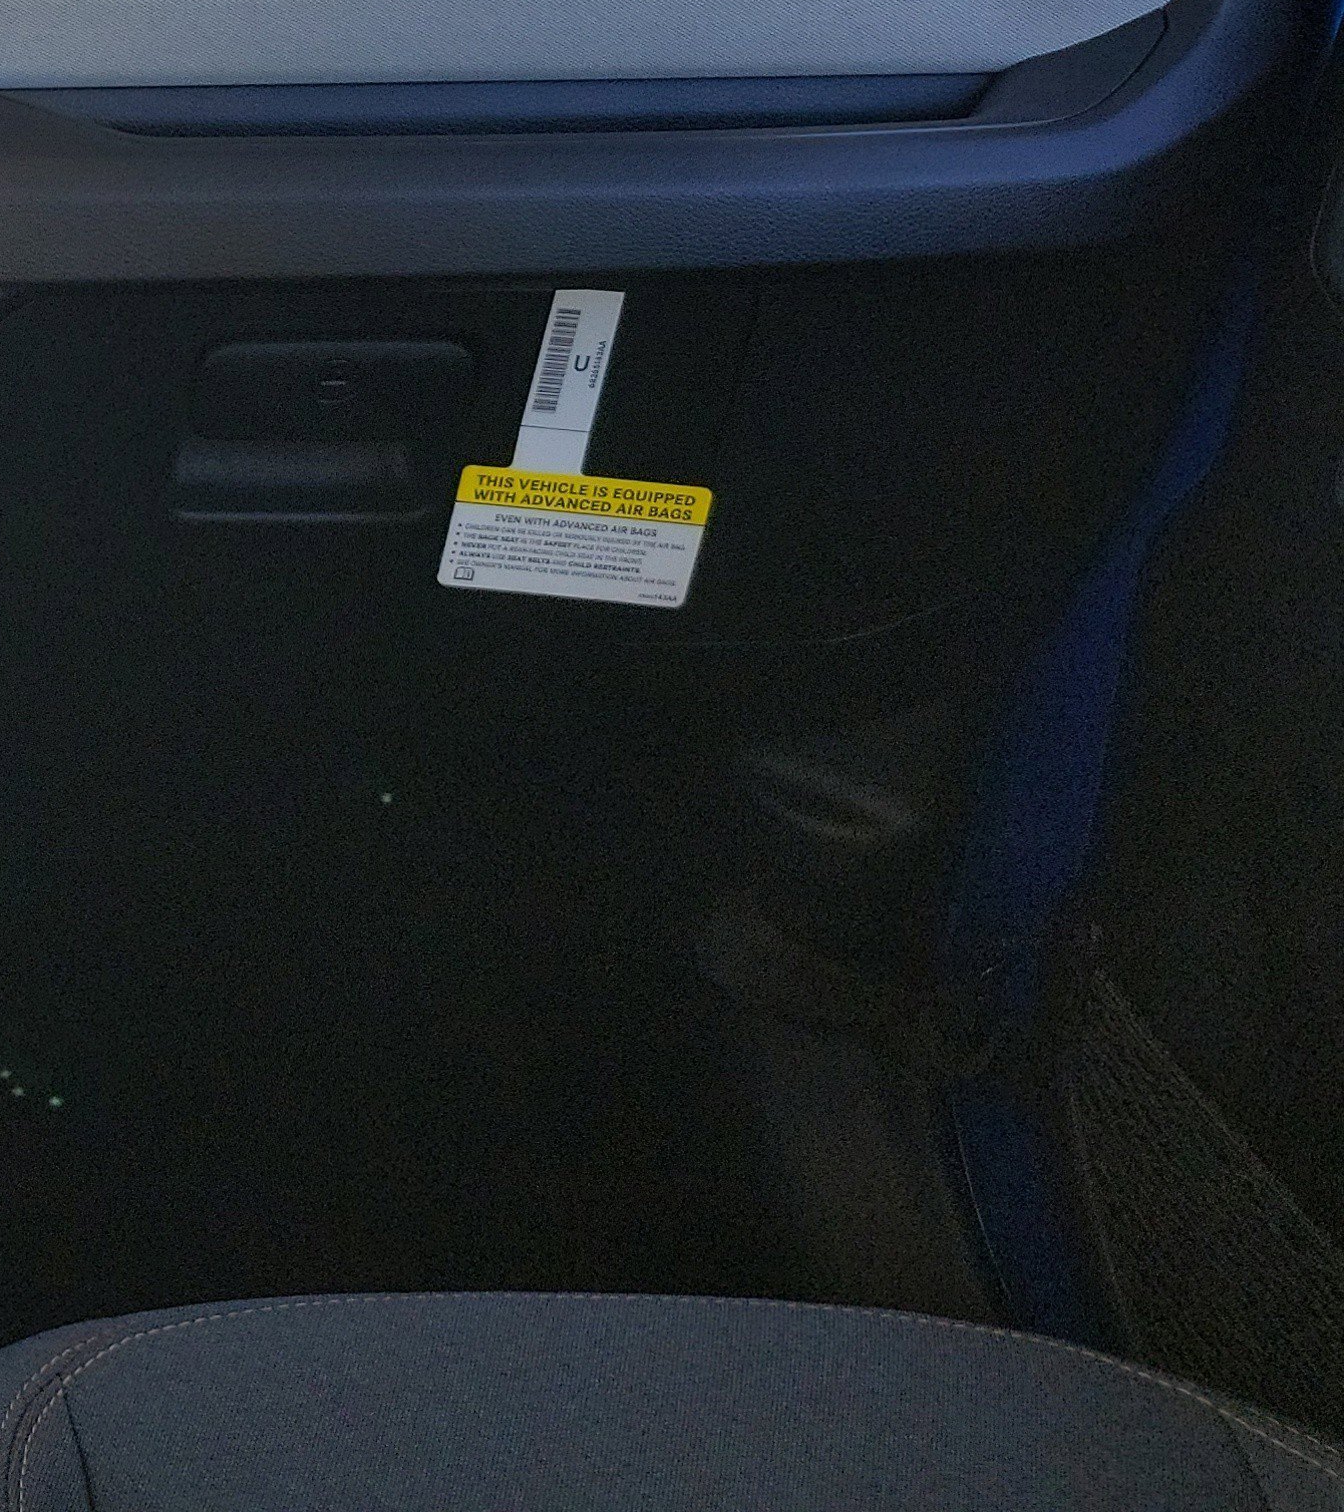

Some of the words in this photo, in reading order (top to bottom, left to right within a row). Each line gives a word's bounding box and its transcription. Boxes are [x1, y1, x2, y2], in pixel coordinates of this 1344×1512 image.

[574, 354, 590, 372] U
[477, 474, 514, 489] THIS
[519, 478, 587, 497] VEHICLE
[592, 485, 608, 498] IS
[613, 486, 696, 507] EQUIPPED
[473, 489, 516, 505] WITH
[520, 493, 611, 513] ADVANCED
[616, 502, 643, 516] AIR
[648, 505, 692, 521] BAGS
[494, 513, 522, 524] EVEN
[524, 516, 551, 528] WITH
[552, 519, 608, 532] ADVANCED
[611, 525, 627, 535] AIR
[630, 527, 657, 538] BAGS
